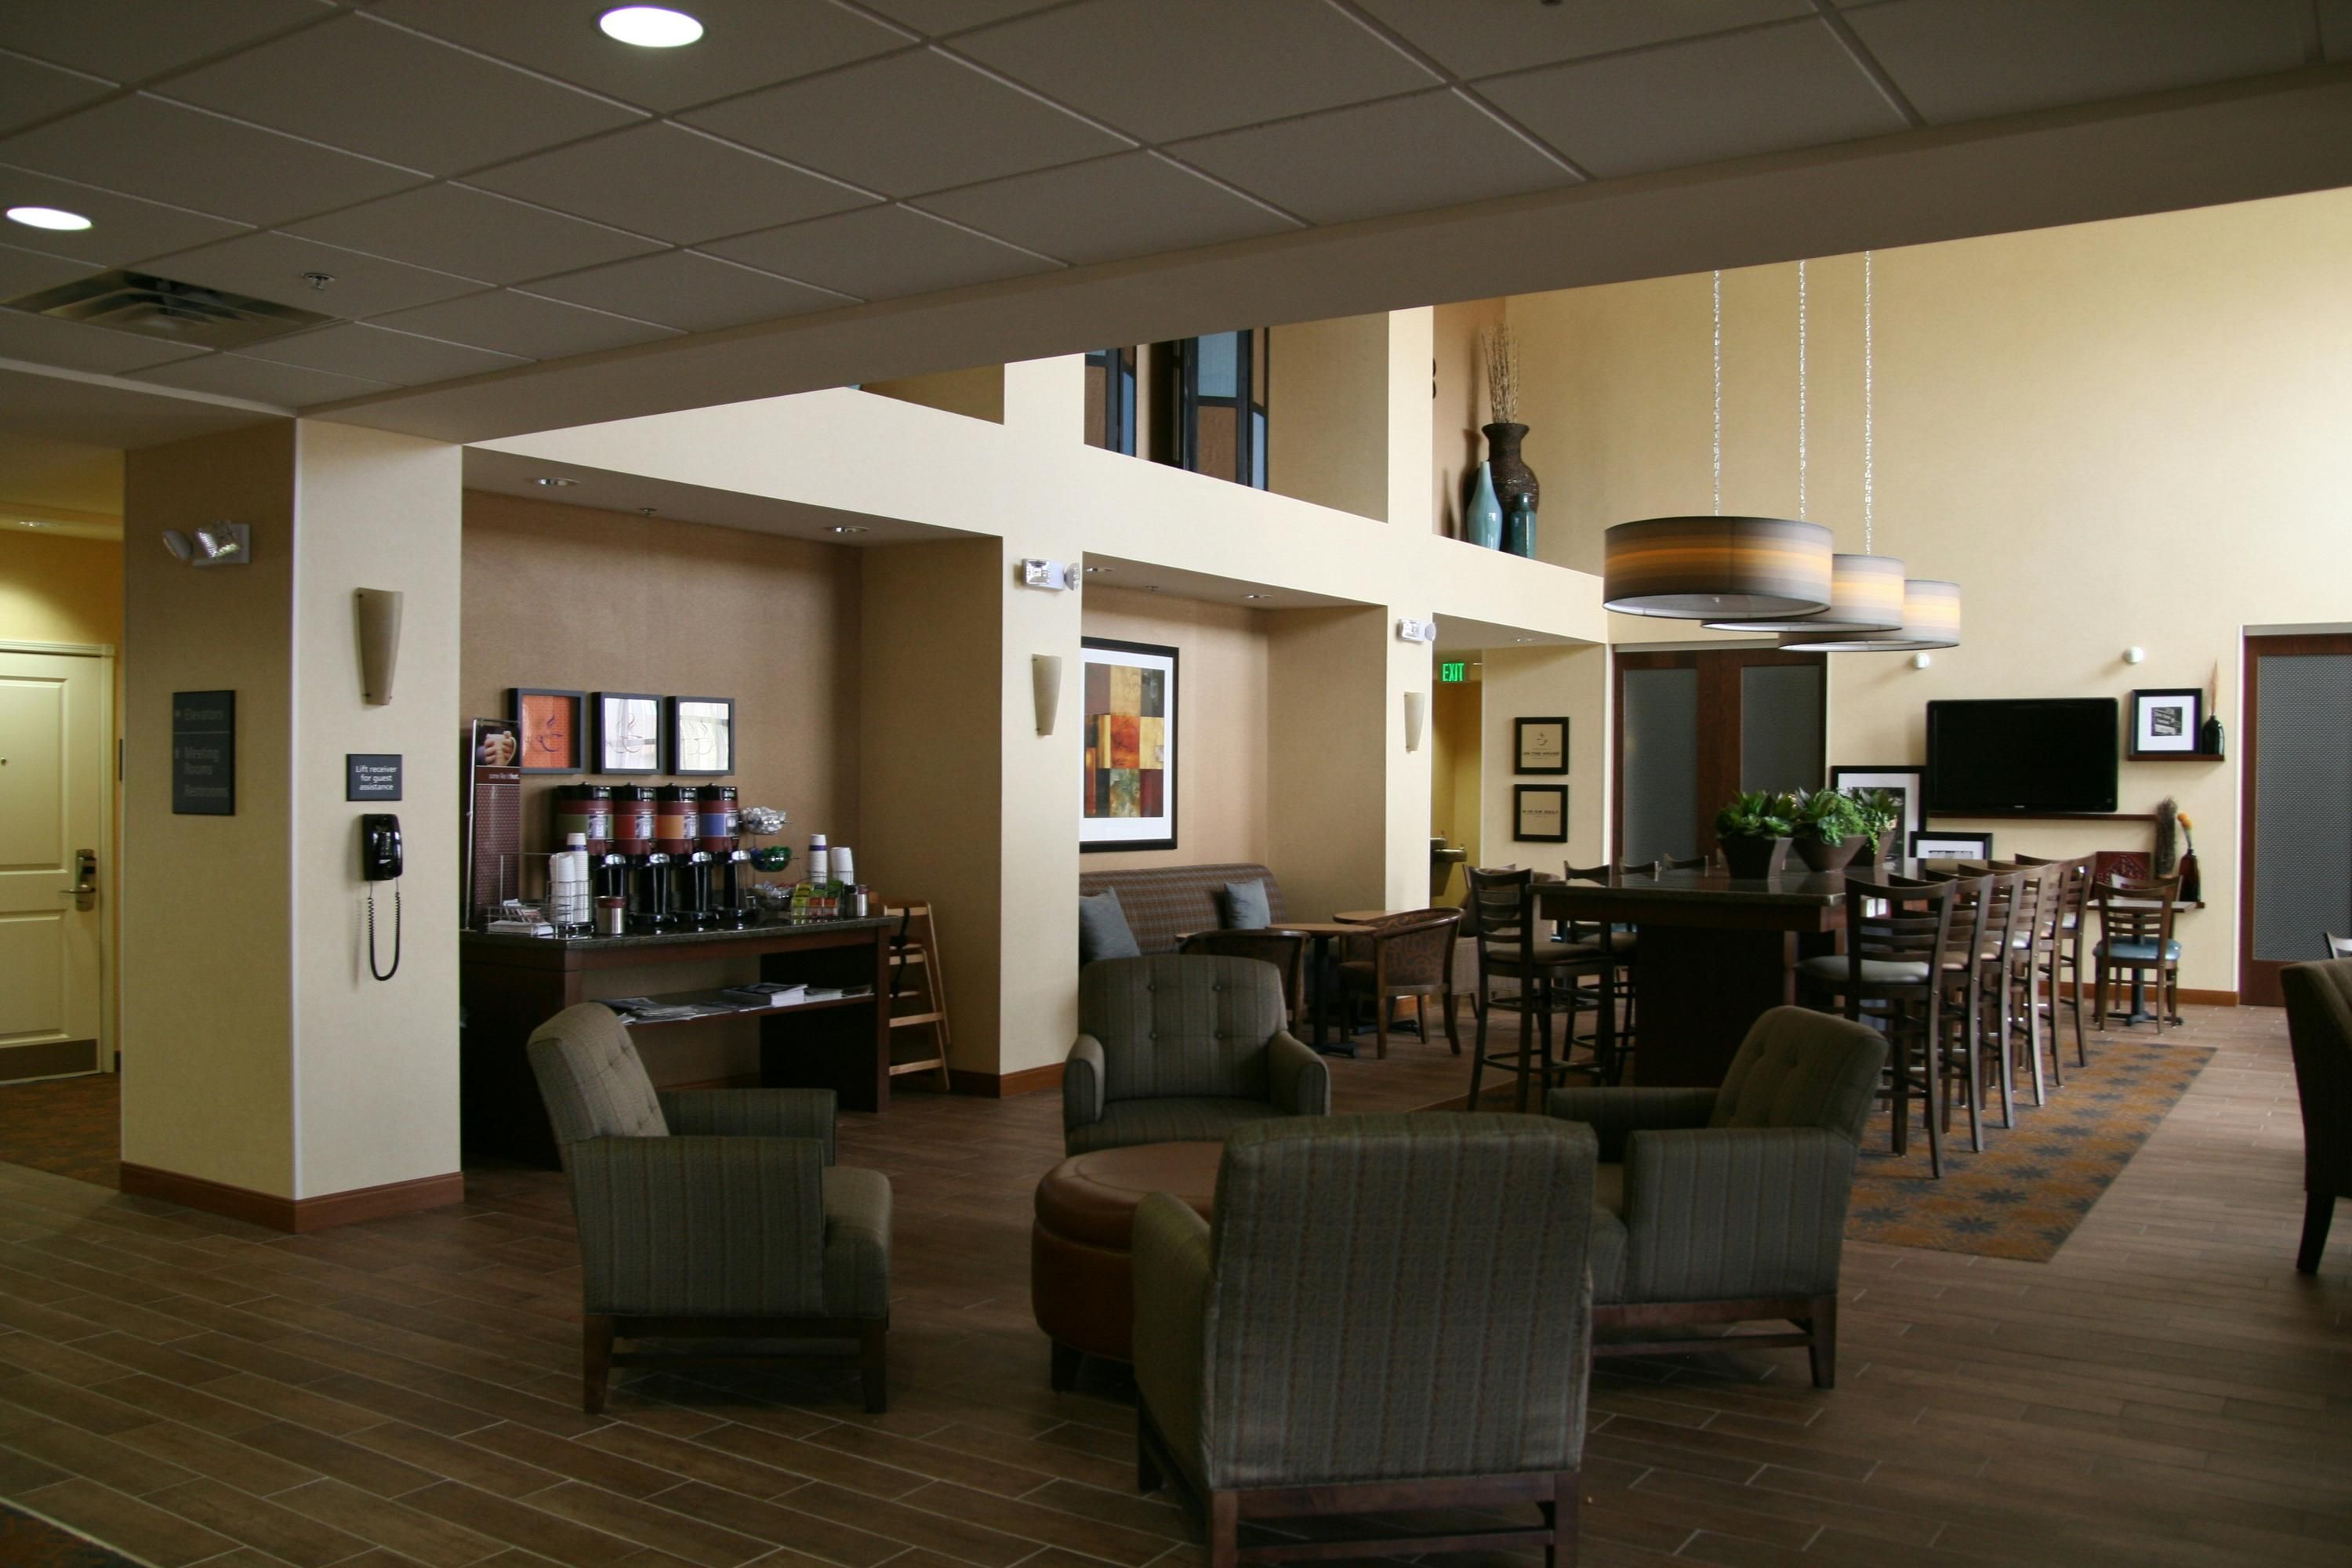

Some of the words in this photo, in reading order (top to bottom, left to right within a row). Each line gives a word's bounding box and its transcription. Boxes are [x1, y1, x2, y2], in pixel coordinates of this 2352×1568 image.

[1443, 662, 1464, 681] EXIT
[184, 708, 224, 721] Elevators
[184, 746, 220, 763] Meeting
[184, 763, 212, 775] Rooms
[355, 764, 368, 773] Lift
[360, 773, 372, 782] for
[184, 783, 228, 797] Restrooms
